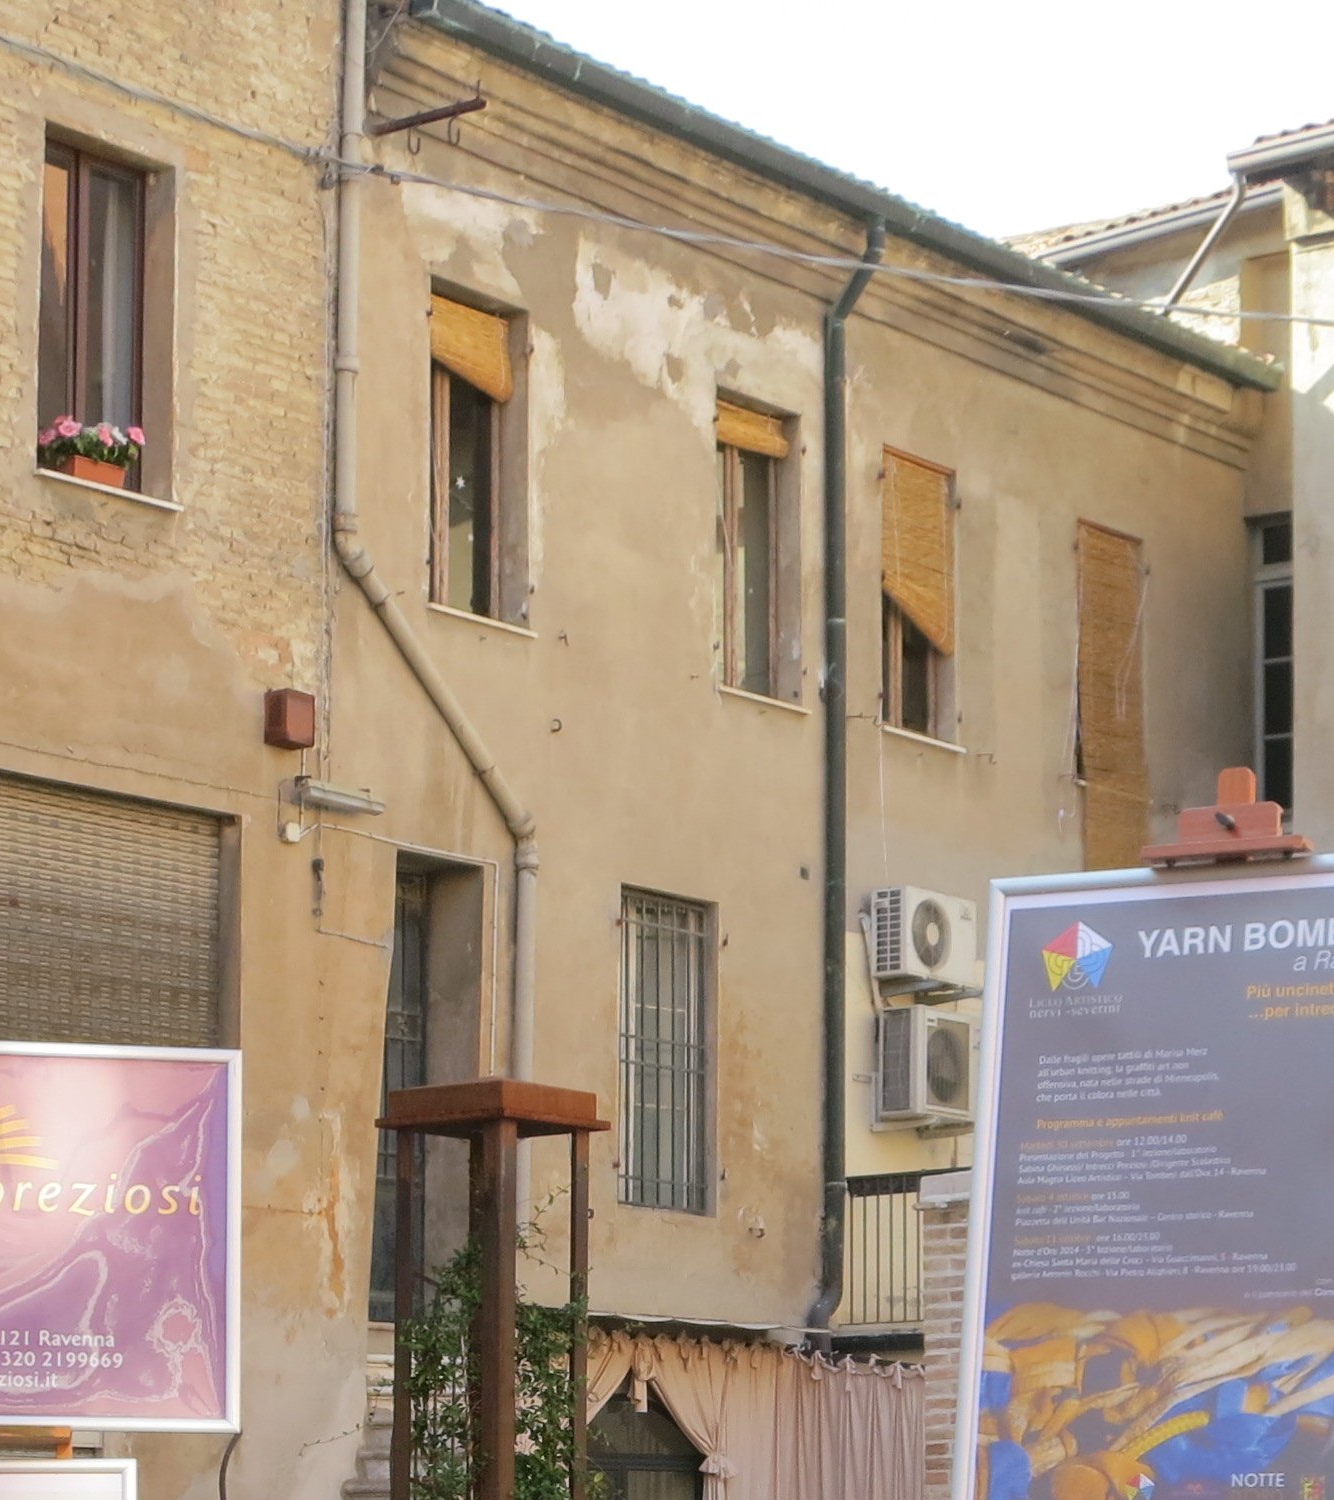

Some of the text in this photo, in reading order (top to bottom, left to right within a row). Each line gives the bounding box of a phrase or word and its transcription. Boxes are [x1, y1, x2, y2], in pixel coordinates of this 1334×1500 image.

[1138, 925, 1233, 958] YARN
[1293, 955, 1306, 971] a
[1247, 984, 1270, 999] Più
[1038, 1054, 1061, 1065] Dalle
[1091, 1053, 1116, 1064] opere
[1144, 1049, 1153, 1059] di
[1125, 1062, 1154, 1074] graffiti
[1157, 1061, 1169, 1071] art
[1172, 1062, 1189, 1070] non
[1079, 1077, 1098, 1087] nata
[1124, 1075, 1151, 1085] strade
[1153, 1074, 1163, 1083] di
[1036, 1093, 1052, 1102] che
[1053, 1091, 1077, 1103] porta
[1037, 1111, 1200, 1131] Programma e appuntamenti knit
[1116, 1139, 1131, 1147] ore
[1037, 1174, 1063, 1185] Magna
[1065, 1173, 1086, 1183] Liceo
[1091, 1193, 1104, 1201] ore
[1050, 1257, 1073, 1267] Santa
[39, 1330, 115, 1347] Ravenna
[1, 1351, 36, 1367] 320
[42, 1351, 123, 1368] 2199669
[1231, 1472, 1285, 1487] NOTTE
